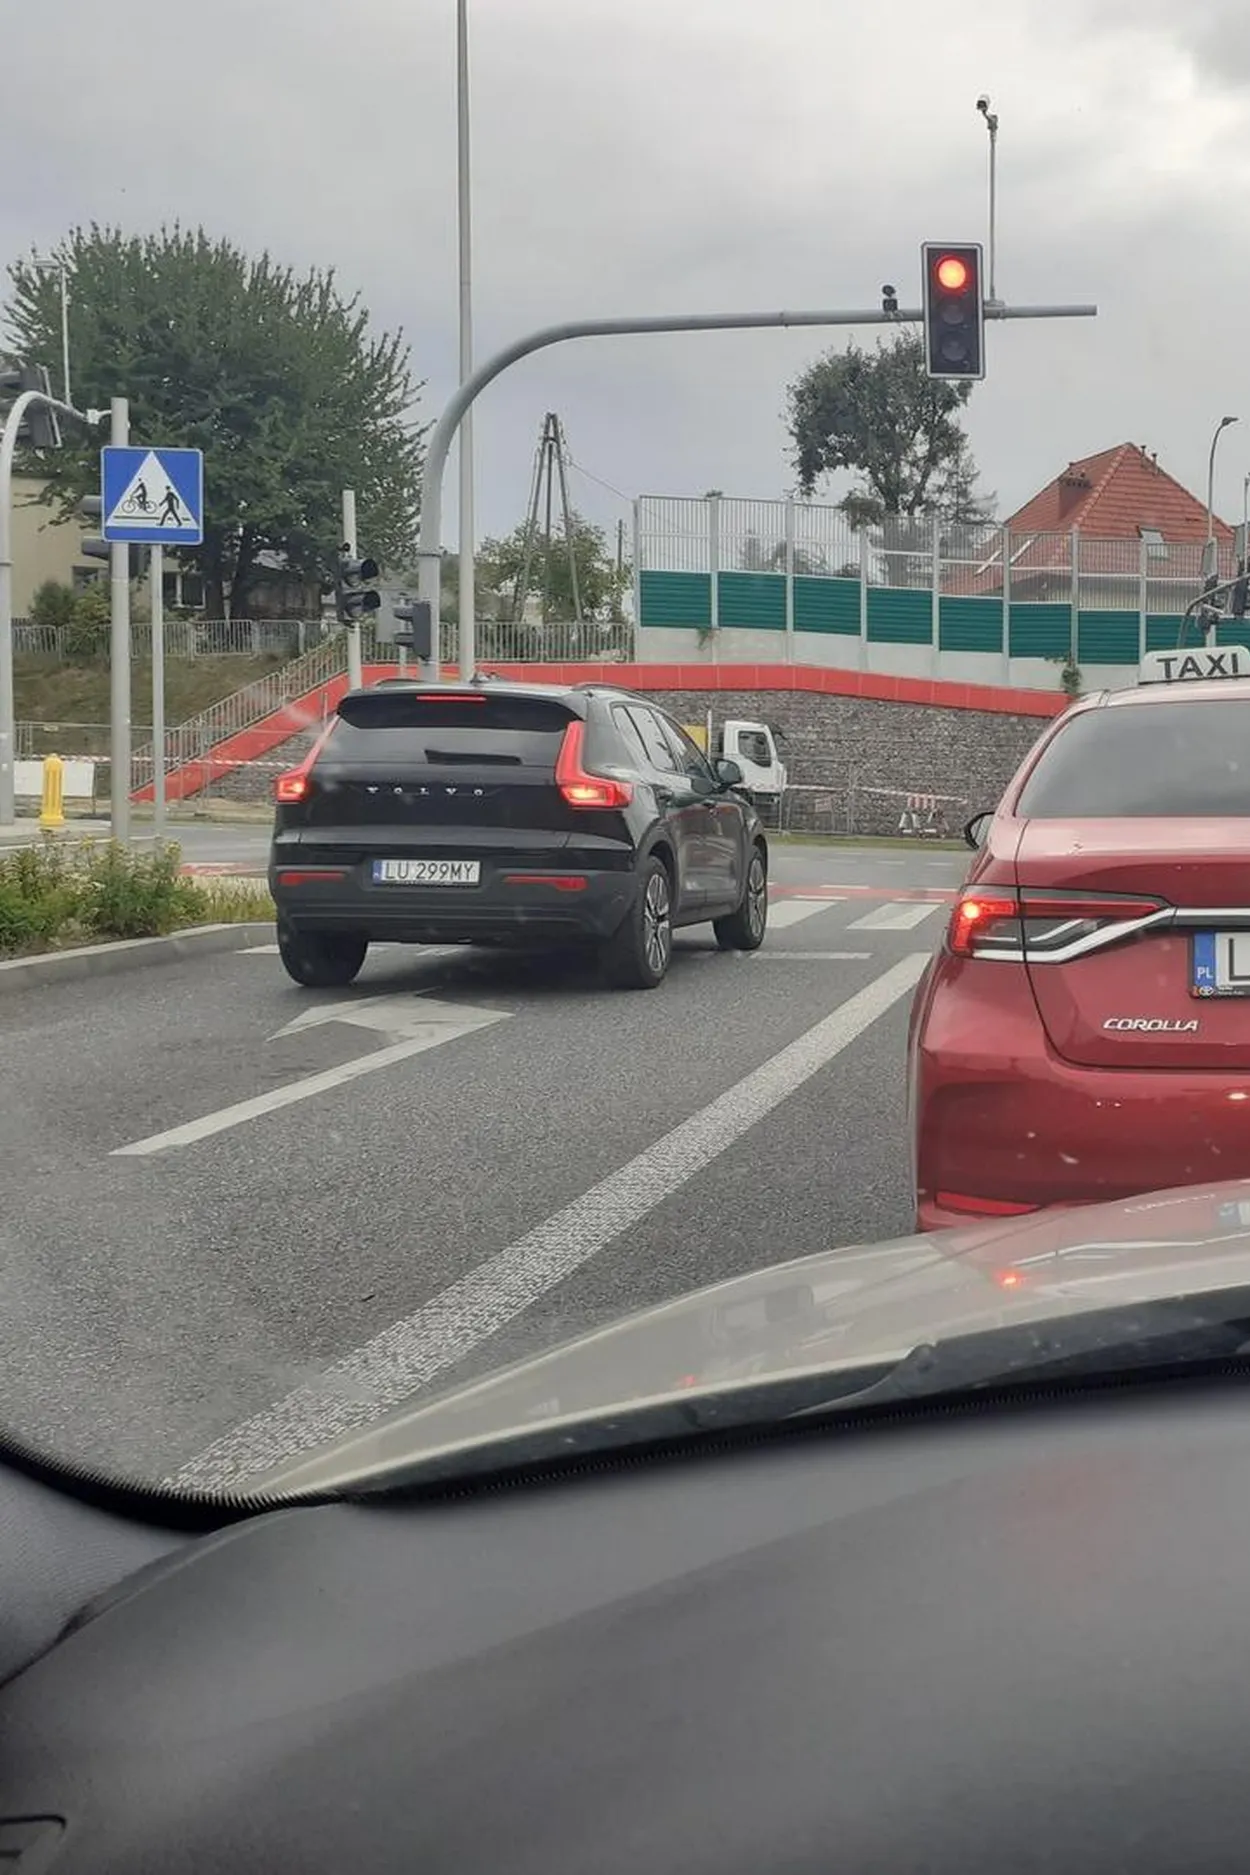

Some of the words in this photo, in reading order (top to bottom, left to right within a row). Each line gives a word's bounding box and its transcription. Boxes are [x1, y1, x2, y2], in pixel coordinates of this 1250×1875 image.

[1156, 652, 1239, 679] TAXI
[365, 786, 484, 796] VOLVO
[385, 862, 409, 880] LU
[415, 862, 474, 880] 299MY
[1196, 966, 1214, 980] PL
[1102, 1017, 1199, 1032] COROLLA
